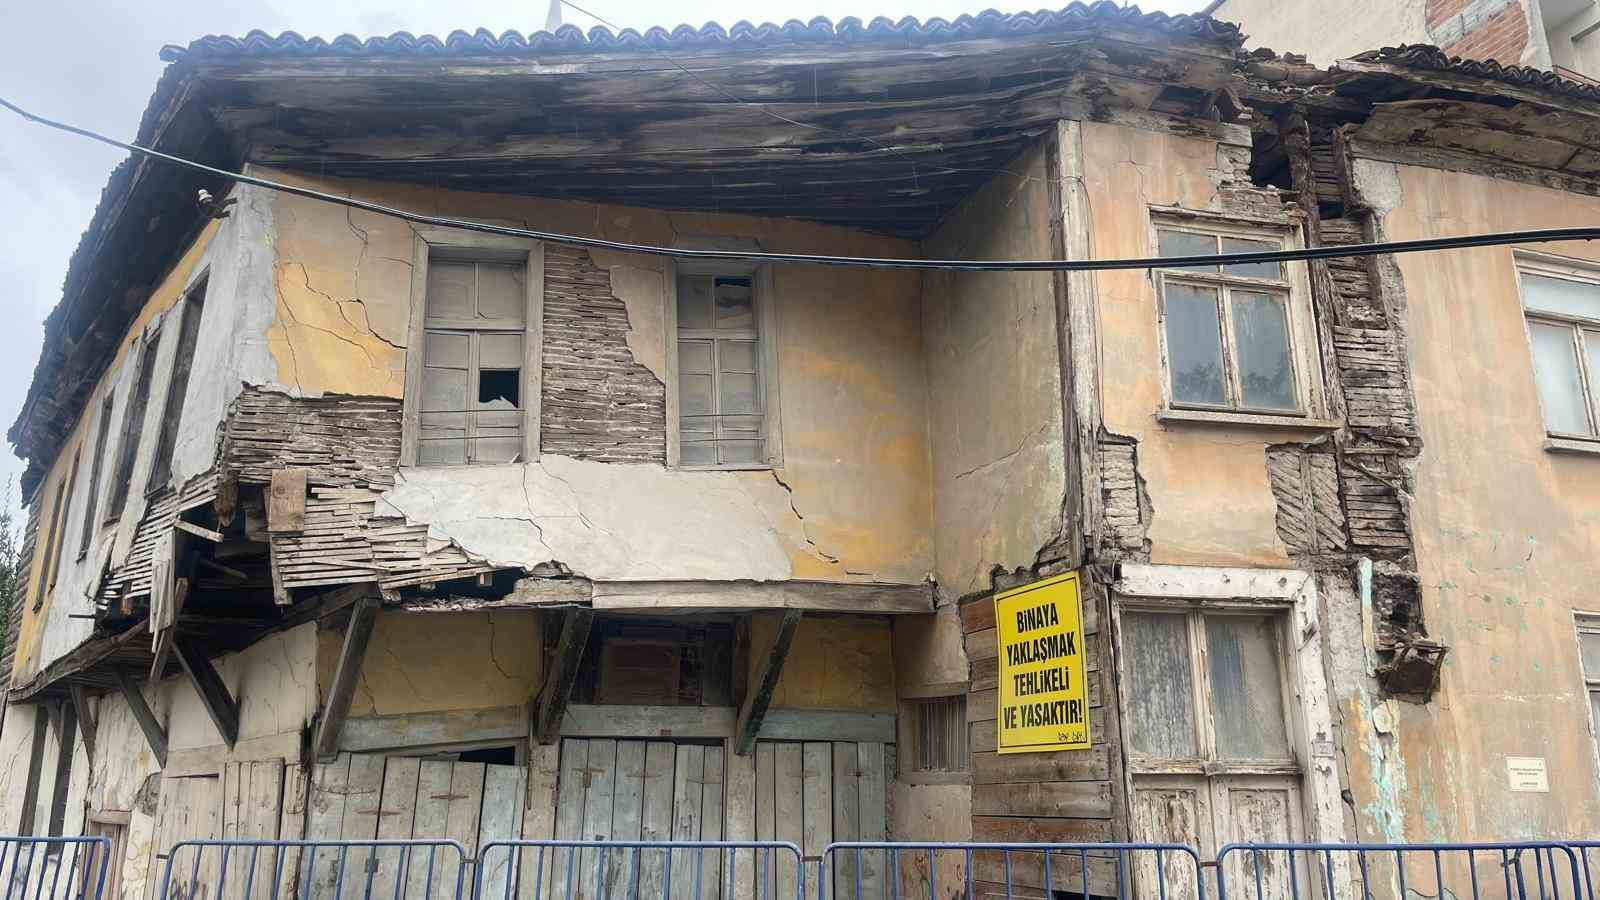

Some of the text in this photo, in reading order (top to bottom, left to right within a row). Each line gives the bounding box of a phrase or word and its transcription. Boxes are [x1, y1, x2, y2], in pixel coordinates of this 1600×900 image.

[1016, 602, 1059, 634] BİNAYA
[1006, 631, 1076, 667] YAKLAŞMAK
[1013, 667, 1070, 697] TEHLİKELİ
[1004, 698, 1083, 730] VE YASAKTIR!
